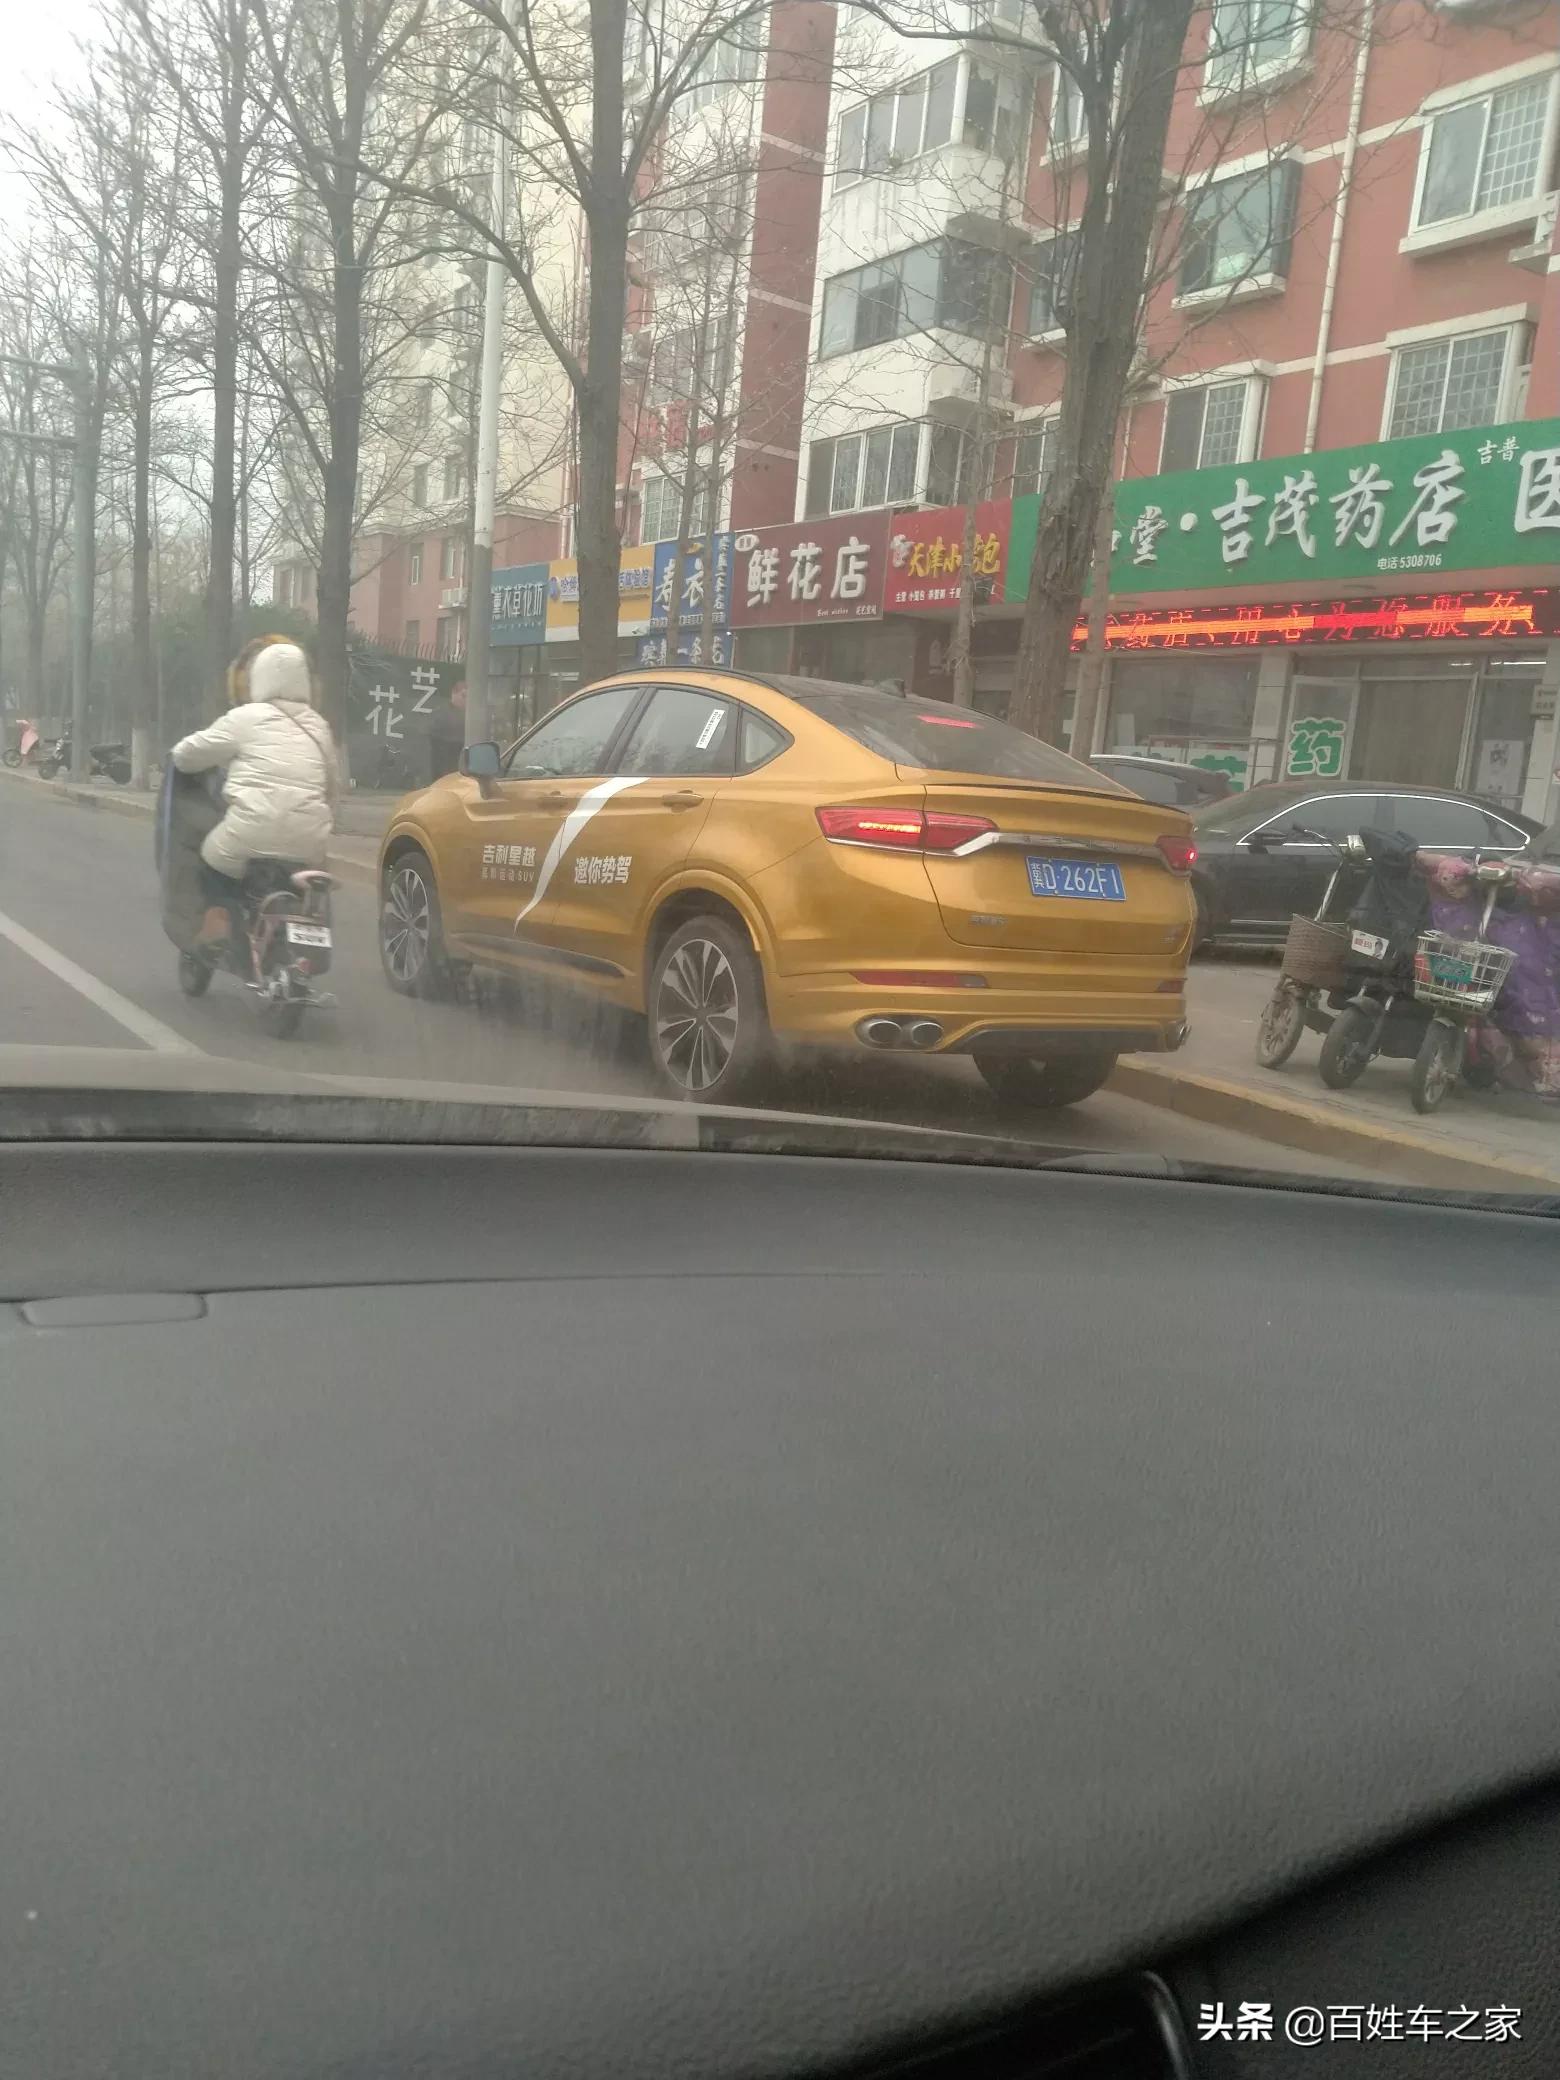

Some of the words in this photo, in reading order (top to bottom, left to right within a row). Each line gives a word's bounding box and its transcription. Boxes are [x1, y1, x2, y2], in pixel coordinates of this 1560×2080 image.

[1090, 450, 1466, 568] 堂·吉茂药店
[747, 536, 871, 607] 鲜花店
[366, 666, 440, 739] 花艺
[1287, 717, 1347, 776] 药
[482, 844, 537, 867] 吉利星越
